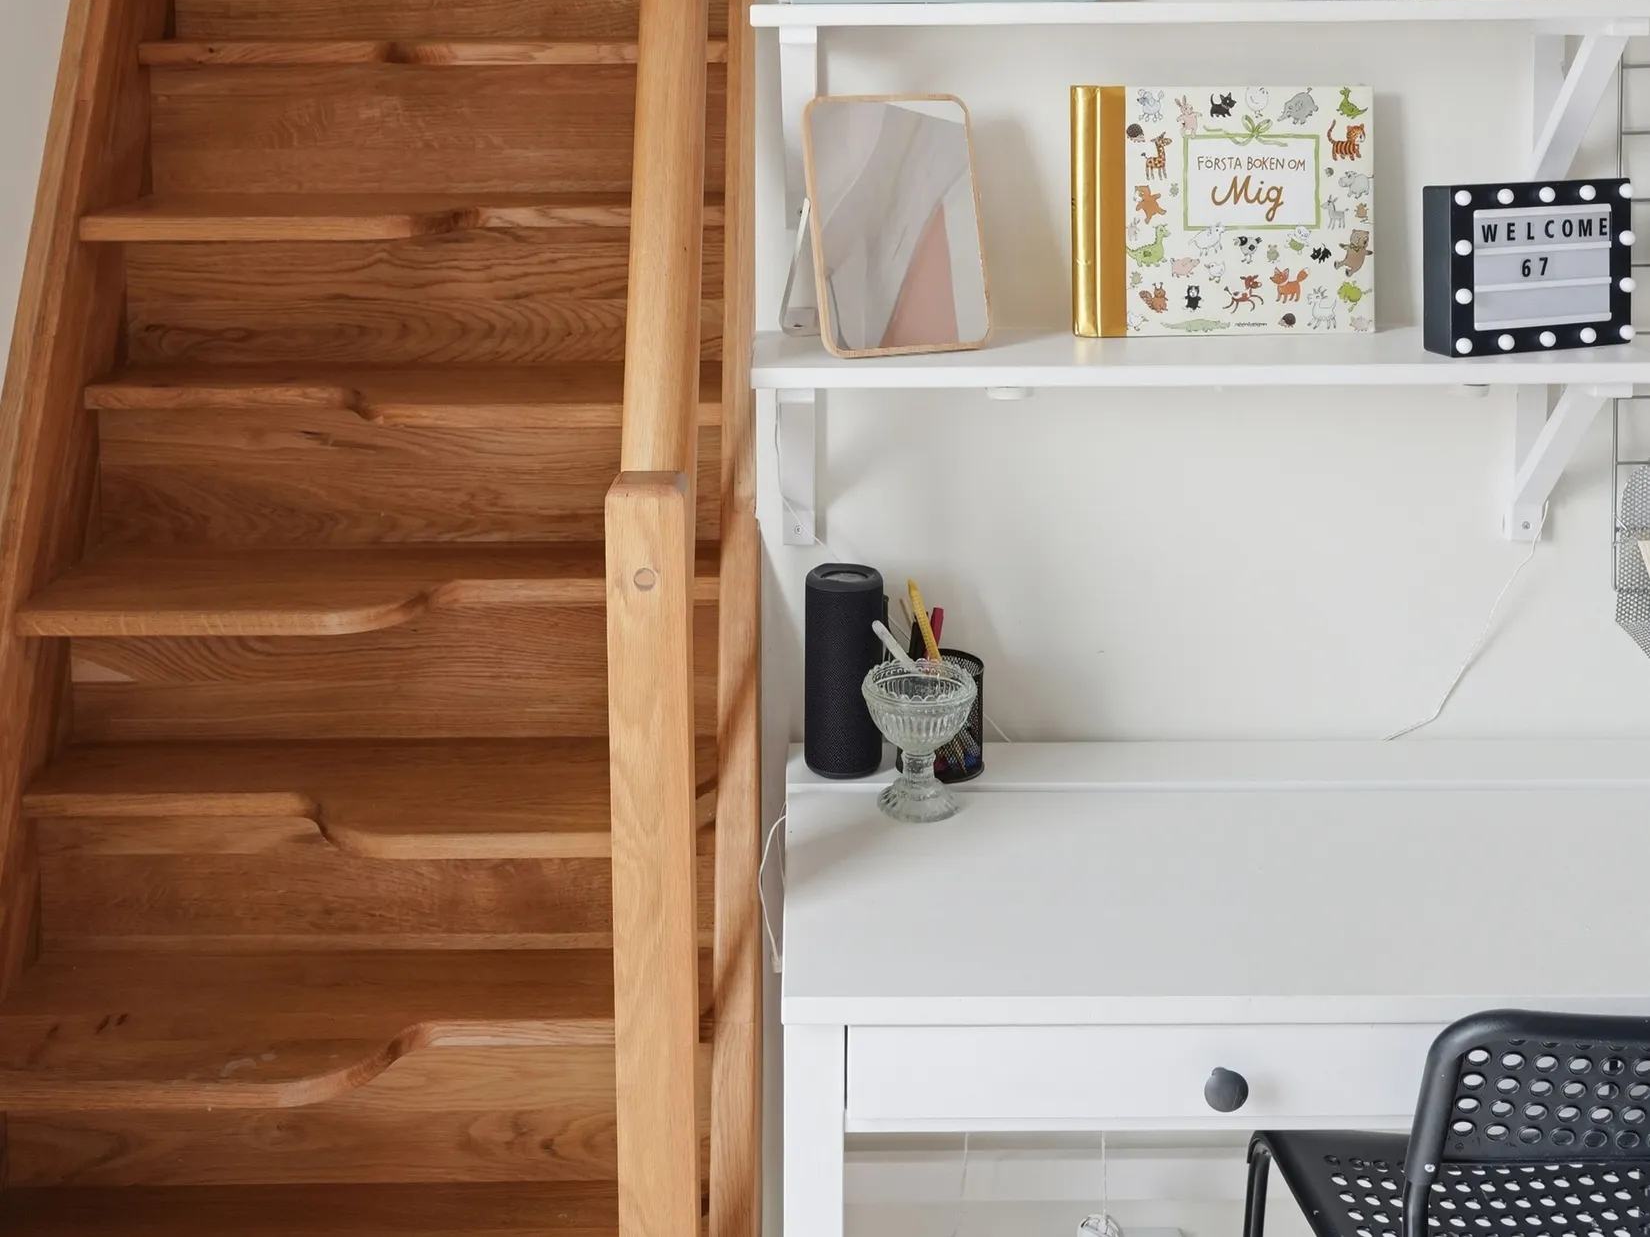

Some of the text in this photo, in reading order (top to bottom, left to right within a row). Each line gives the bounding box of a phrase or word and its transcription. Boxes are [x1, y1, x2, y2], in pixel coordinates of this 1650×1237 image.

[1197, 155, 1306, 172] FÖRSTA BOKEN OM
[1211, 175, 1284, 222] Mig
[1481, 217, 1608, 244] WELCOME
[1521, 256, 1549, 278] 67
